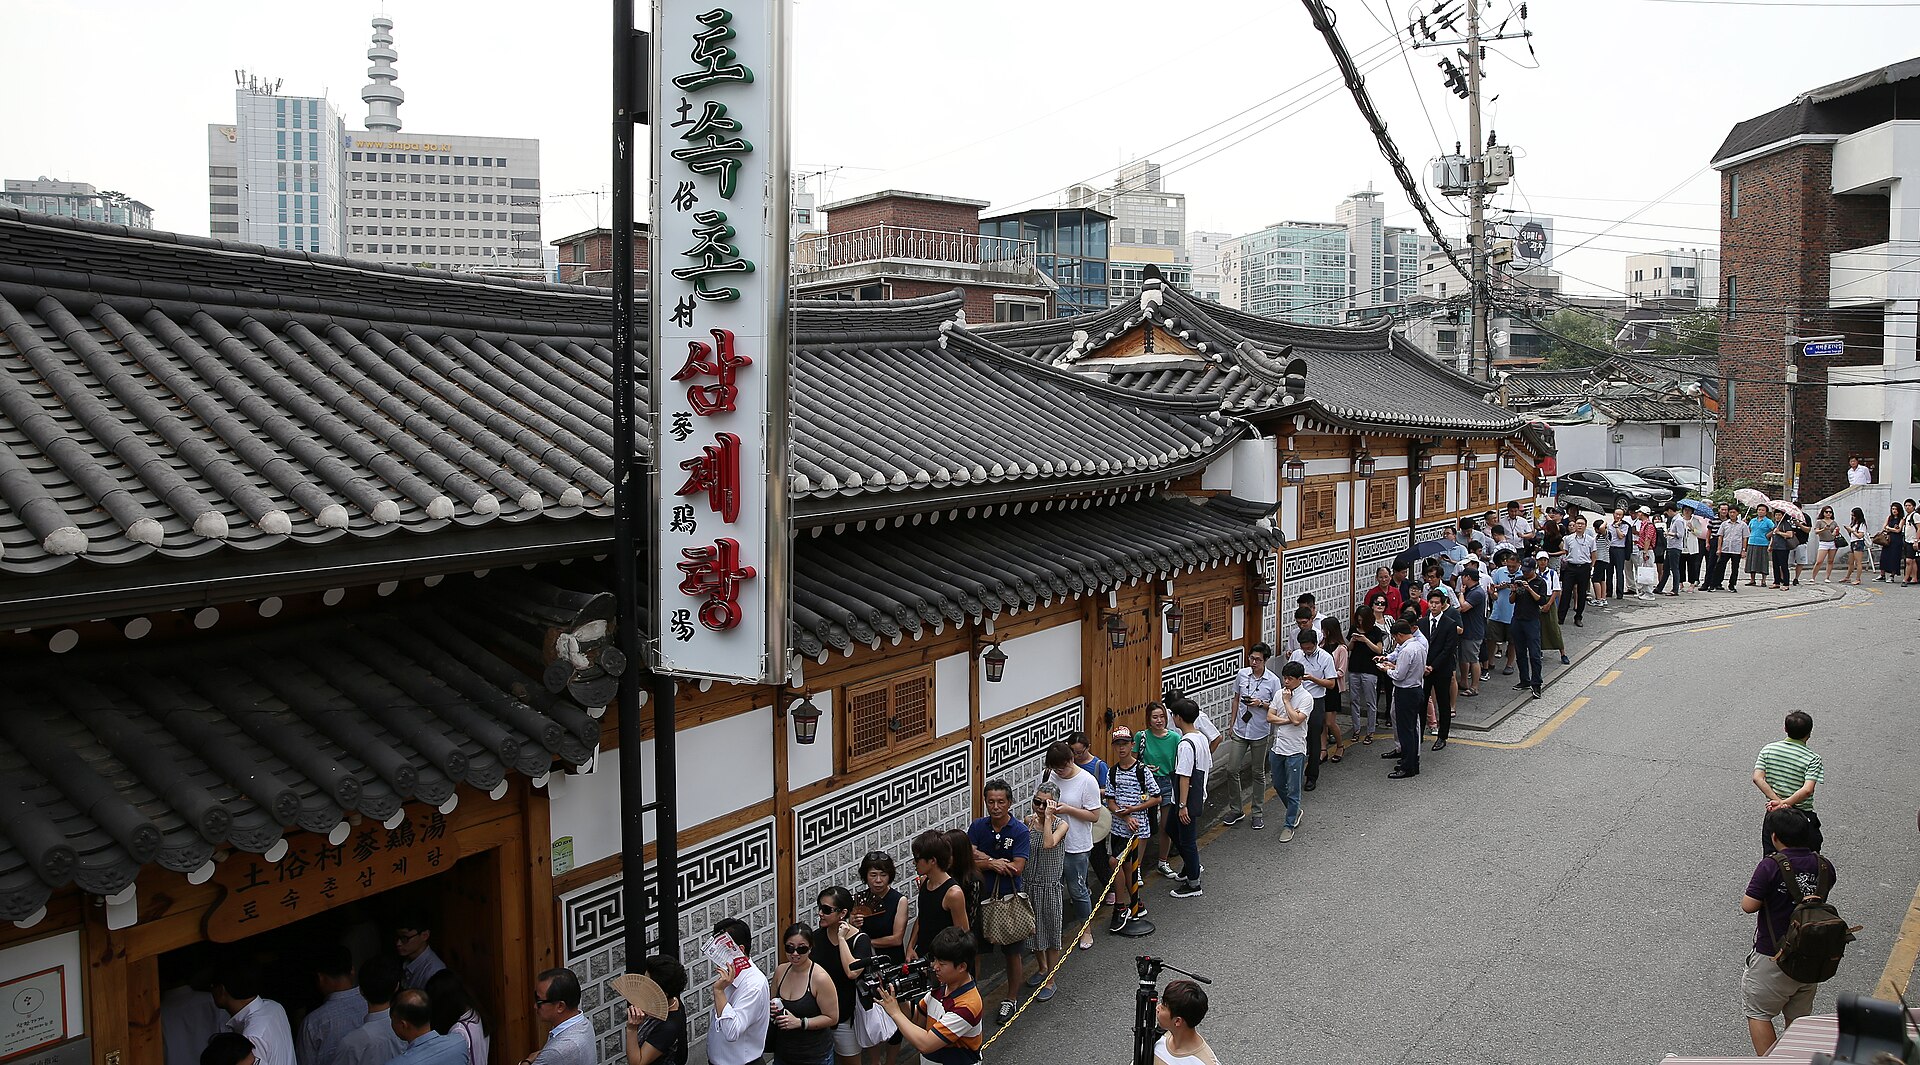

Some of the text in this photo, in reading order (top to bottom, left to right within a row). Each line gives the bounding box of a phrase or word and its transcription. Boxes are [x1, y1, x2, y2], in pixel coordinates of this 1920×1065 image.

[356, 140, 452, 152] www.smpa.go.kr
[671, 8, 756, 632] 토속촌 삼계탕
